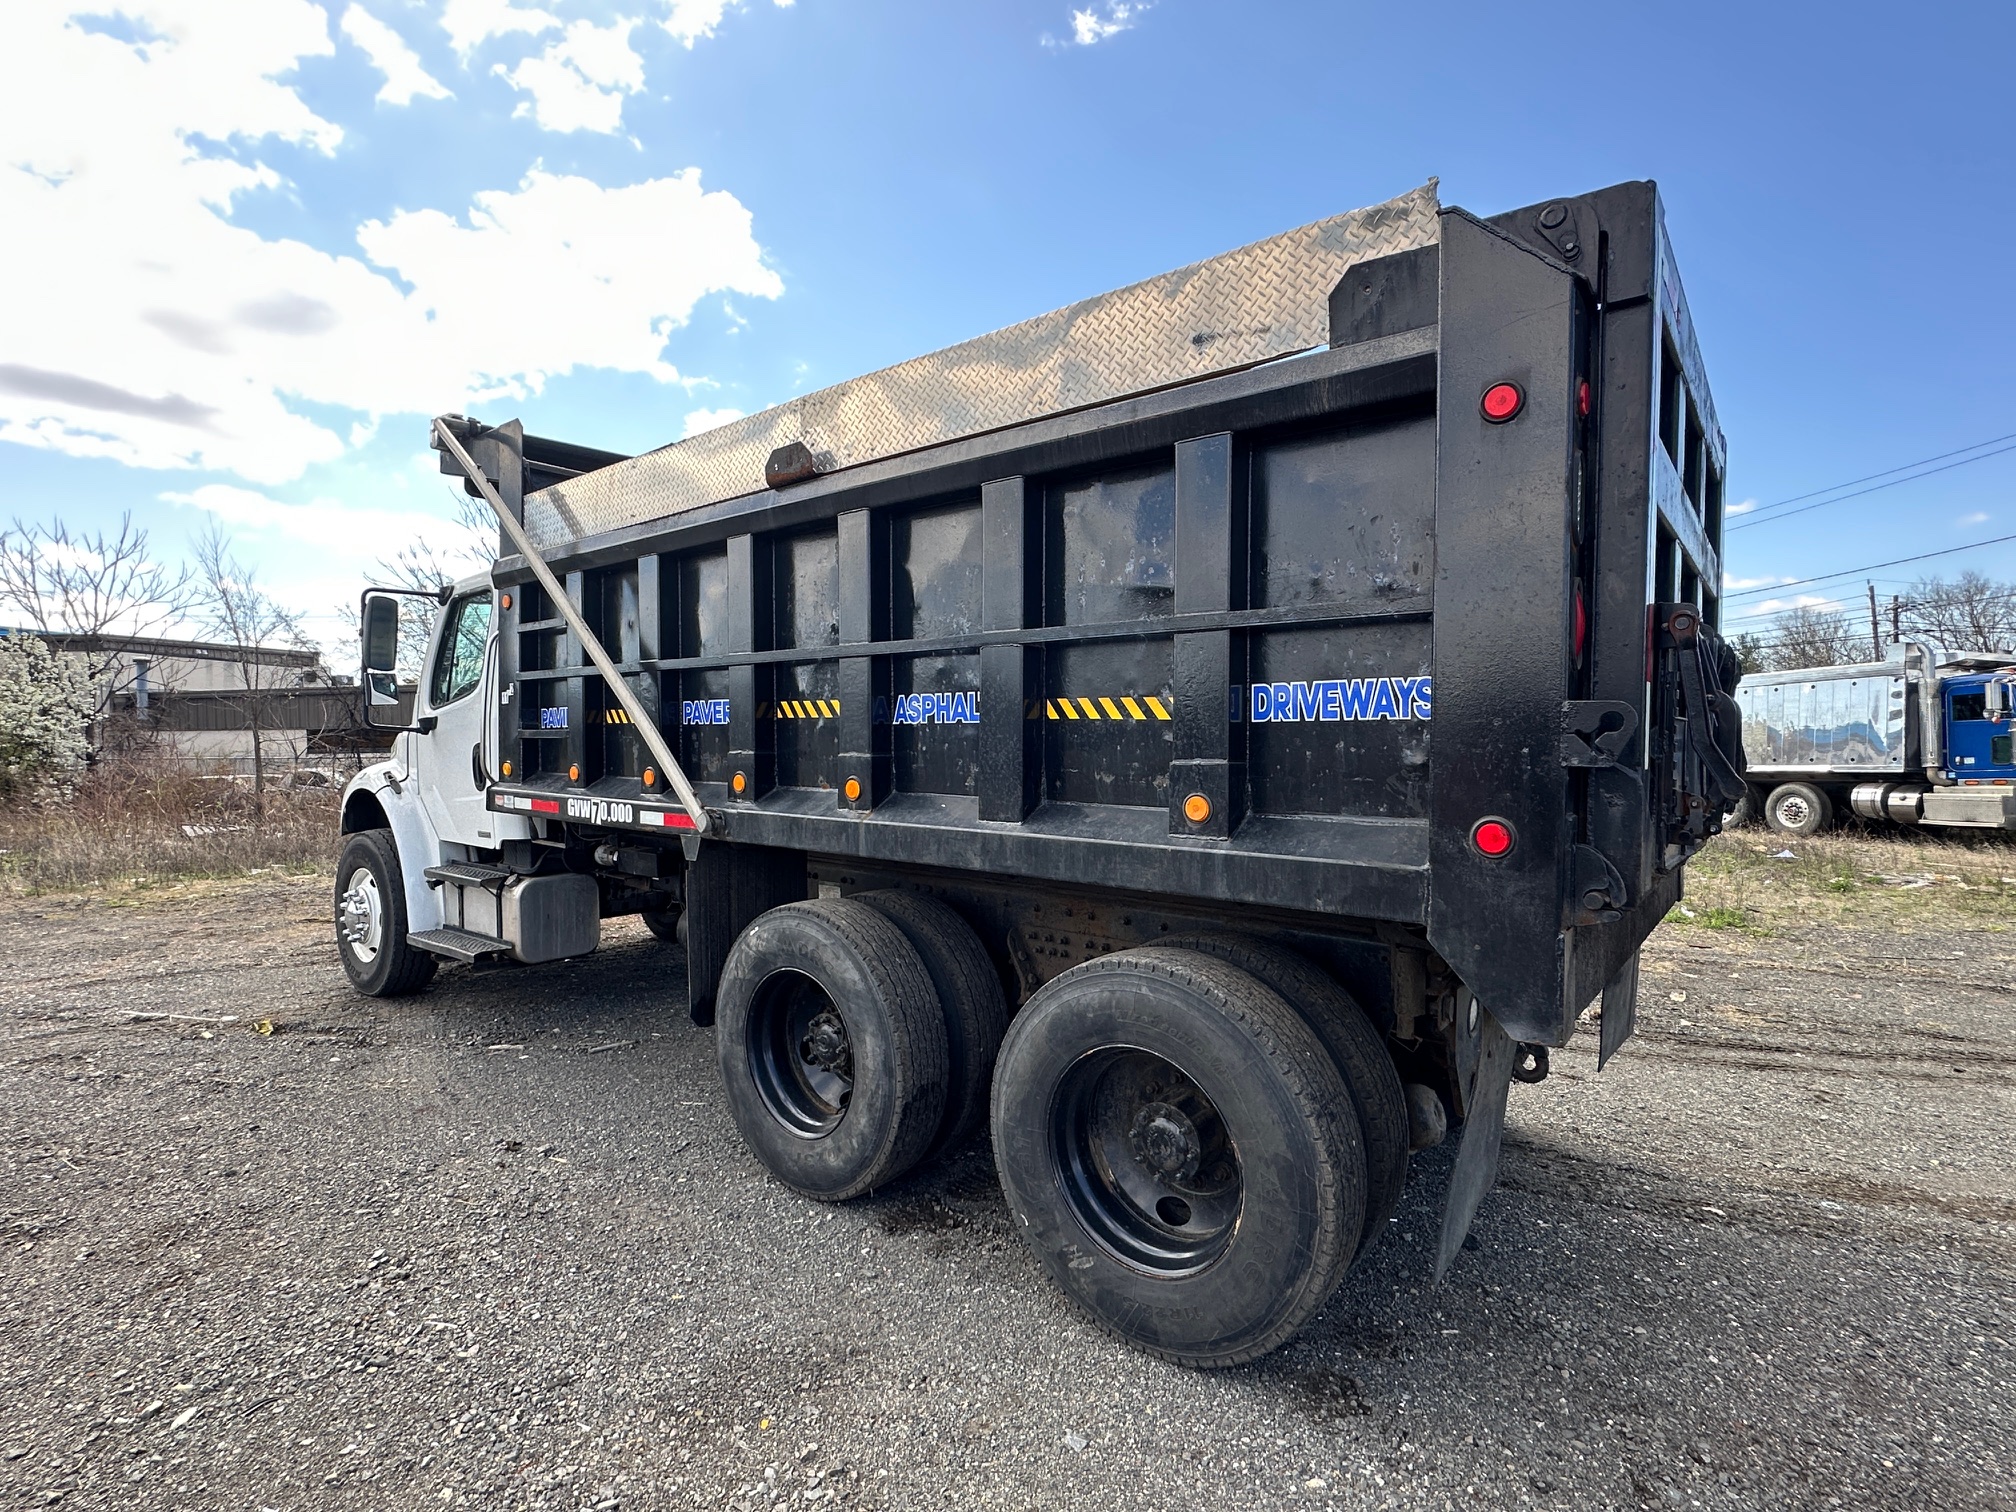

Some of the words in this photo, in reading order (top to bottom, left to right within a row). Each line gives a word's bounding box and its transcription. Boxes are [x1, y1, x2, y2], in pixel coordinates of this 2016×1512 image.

[893, 691, 980, 725] ASPHAL
[1251, 676, 1432, 722] DRIVEWAYS
[567, 798, 591, 818] GVW
